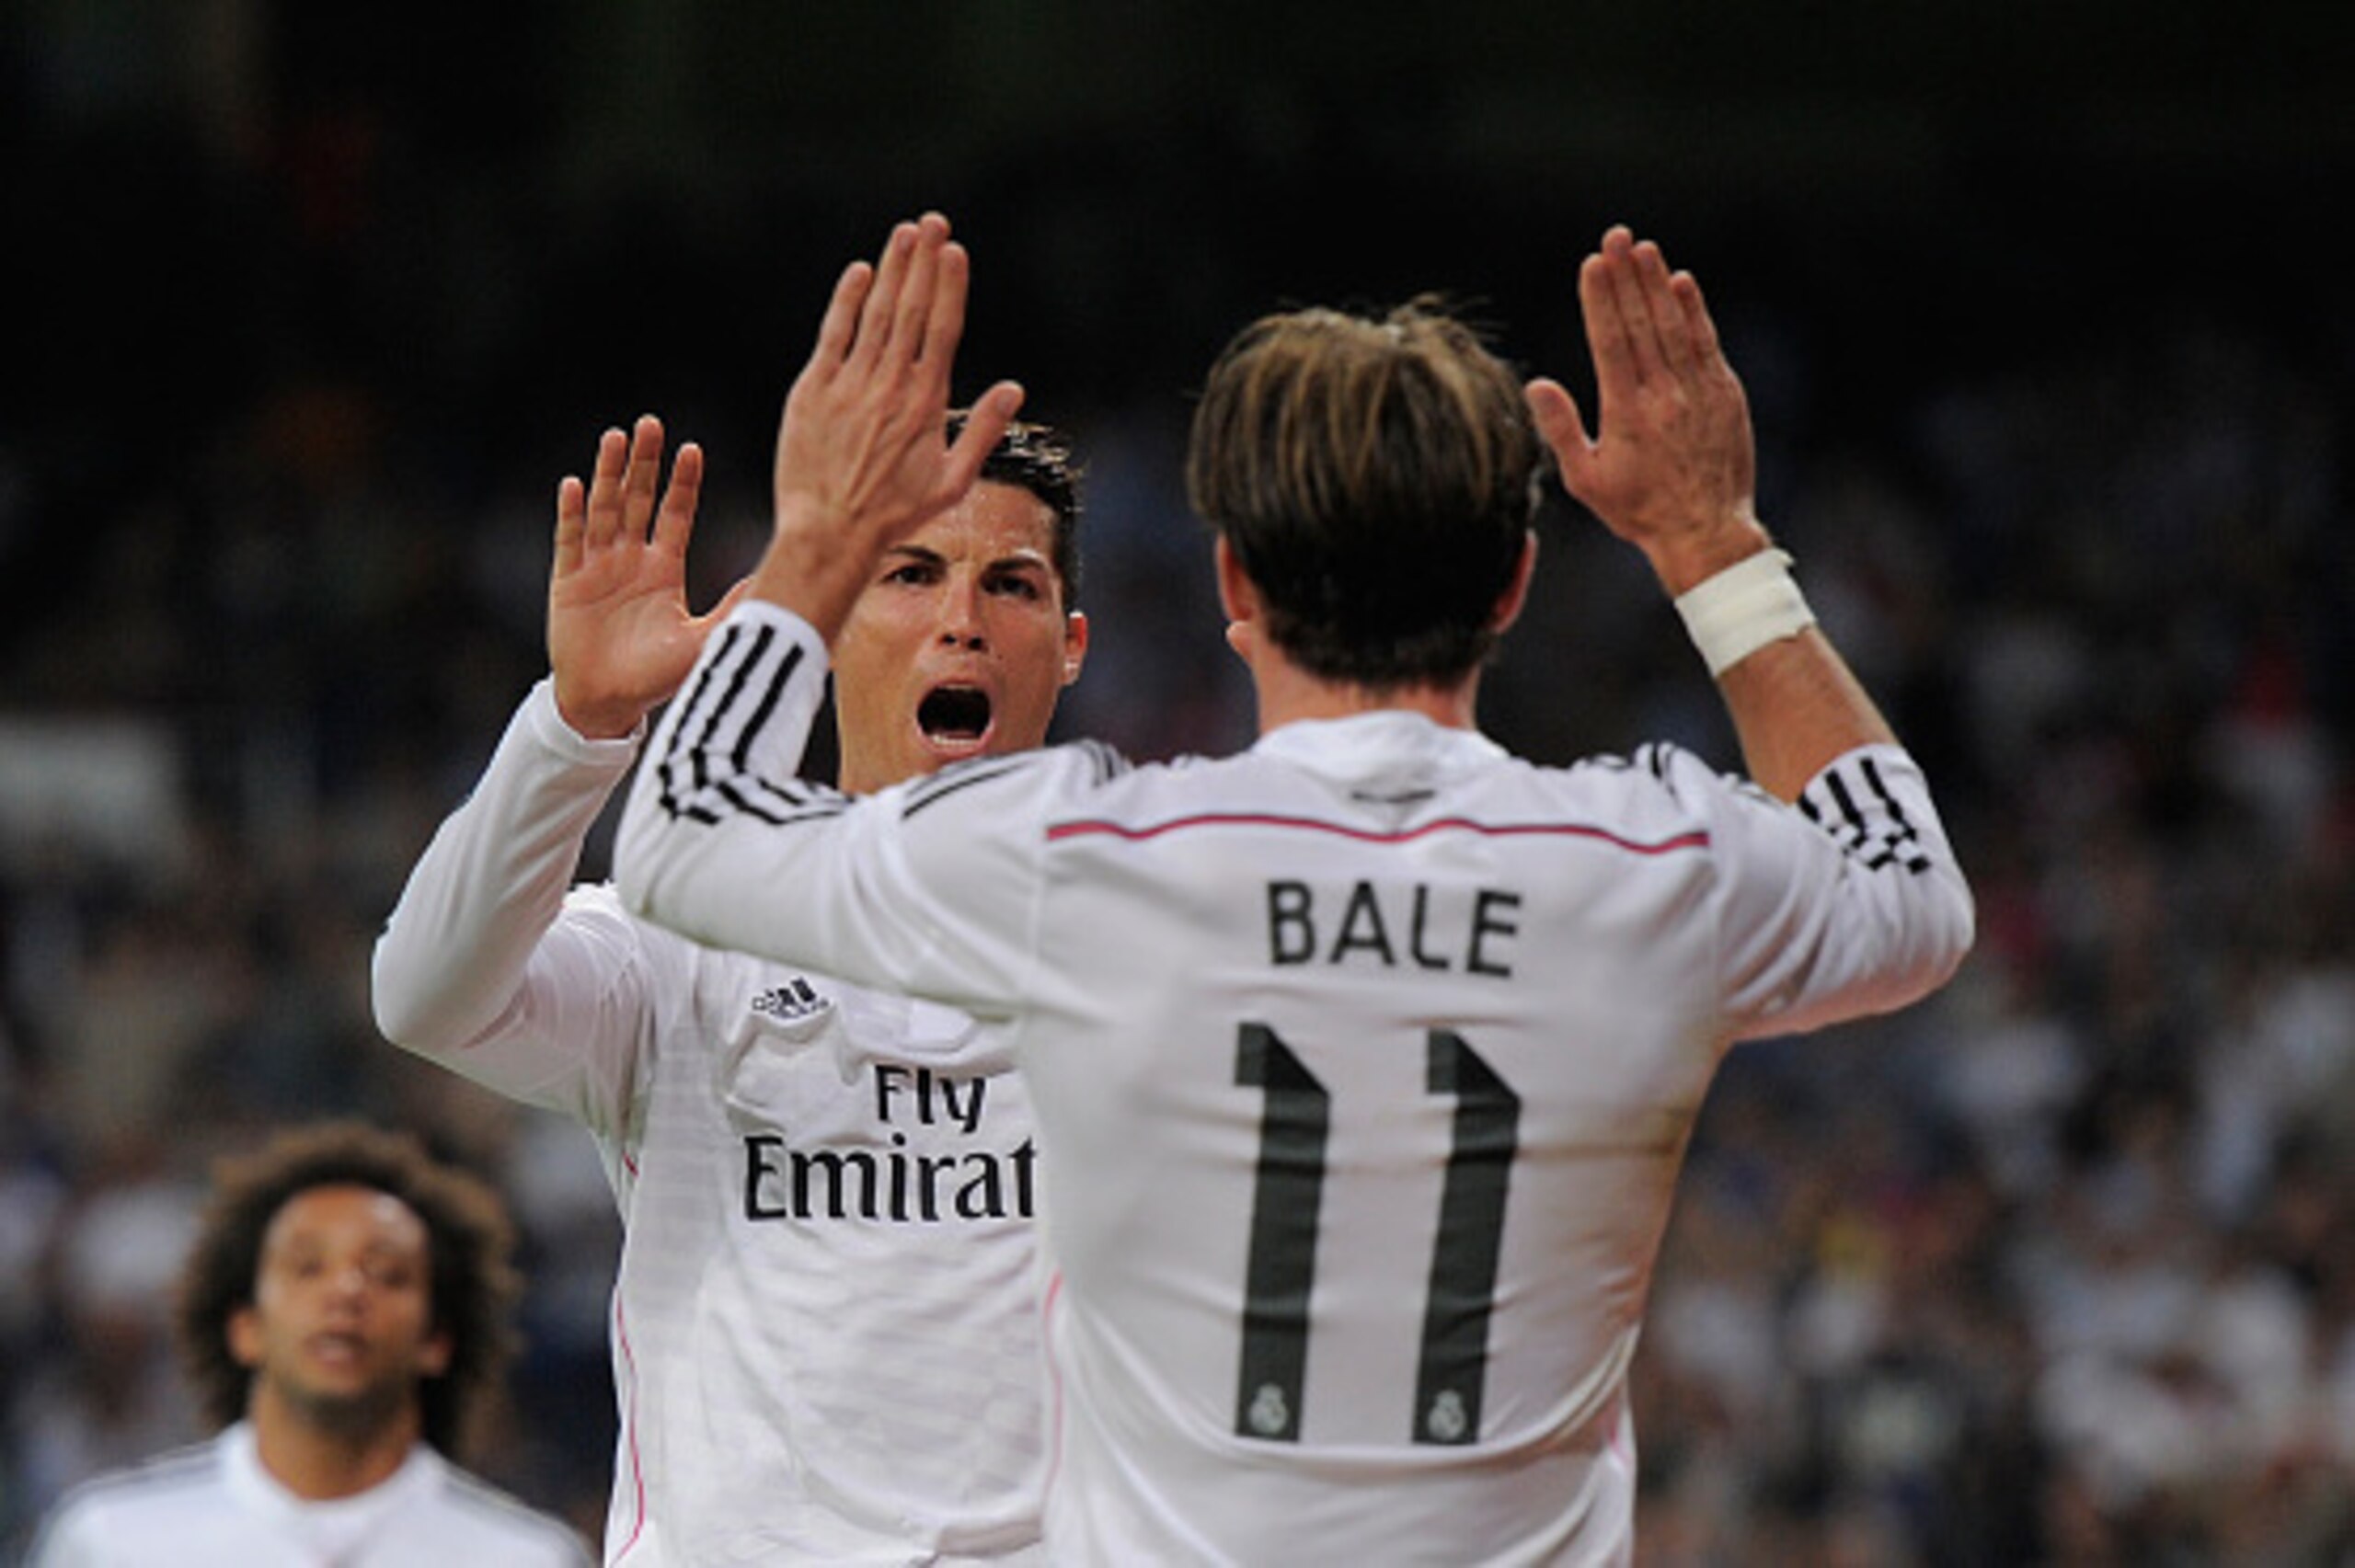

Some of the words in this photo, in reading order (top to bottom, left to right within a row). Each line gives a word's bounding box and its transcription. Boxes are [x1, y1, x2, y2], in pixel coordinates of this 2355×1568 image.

[1267, 880, 1522, 979] BALE
[874, 1064, 986, 1134] Fly
[1233, 1022, 1523, 1446] 11
